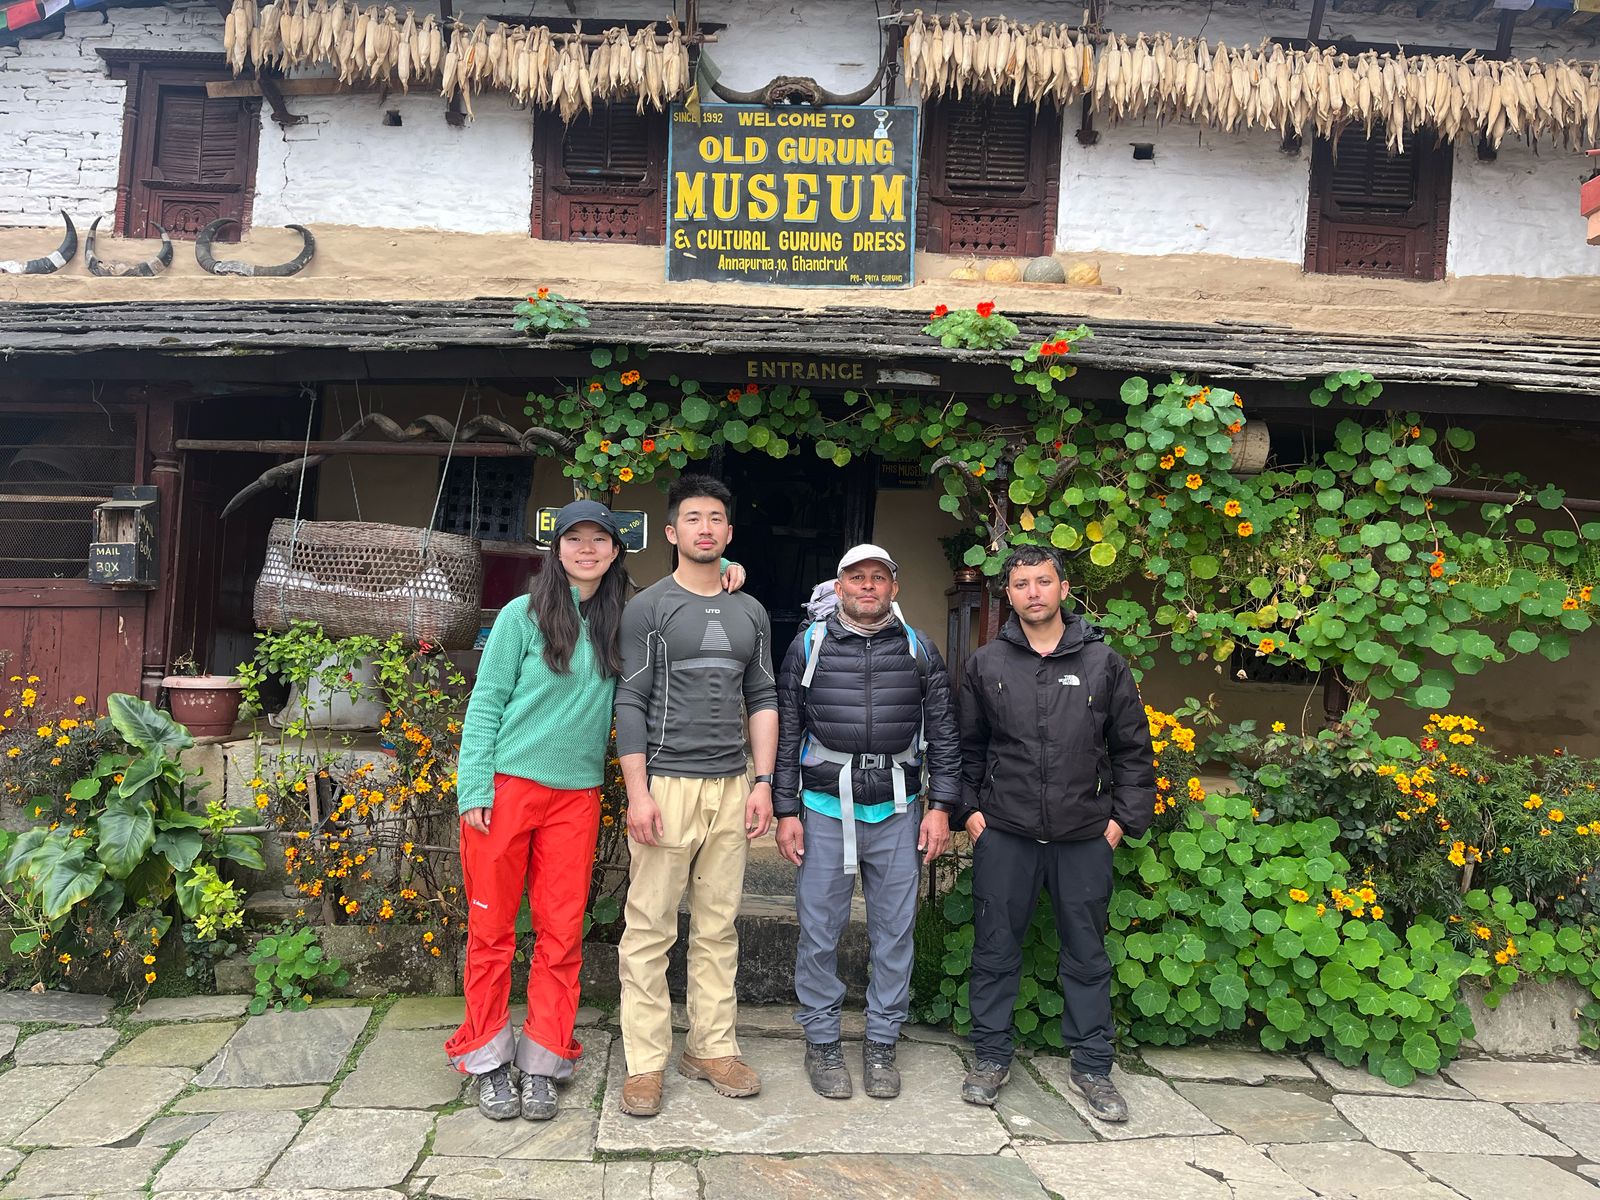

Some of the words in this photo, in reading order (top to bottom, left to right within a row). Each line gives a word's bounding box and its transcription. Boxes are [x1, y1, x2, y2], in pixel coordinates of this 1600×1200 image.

[673, 112, 697, 123] SINCE
[703, 112, 723, 123] 1992
[738, 112, 827, 128] WELCOME
[831, 113, 855, 129] TO
[699, 136, 768, 164] OLD
[777, 137, 895, 166] GURUNG
[674, 172, 906, 222] MUSEUM
[674, 228, 691, 249] &
[697, 229, 770, 251] CULTURAL
[779, 230, 843, 252] GURUNG
[853, 231, 906, 252] DRESS
[747, 360, 863, 380] ENTRANCE
[881, 464, 898, 473] THIS
[898, 463, 923, 477] MUSE
[96, 548, 120, 556] MAIL
[96, 562, 119, 572] BOX
